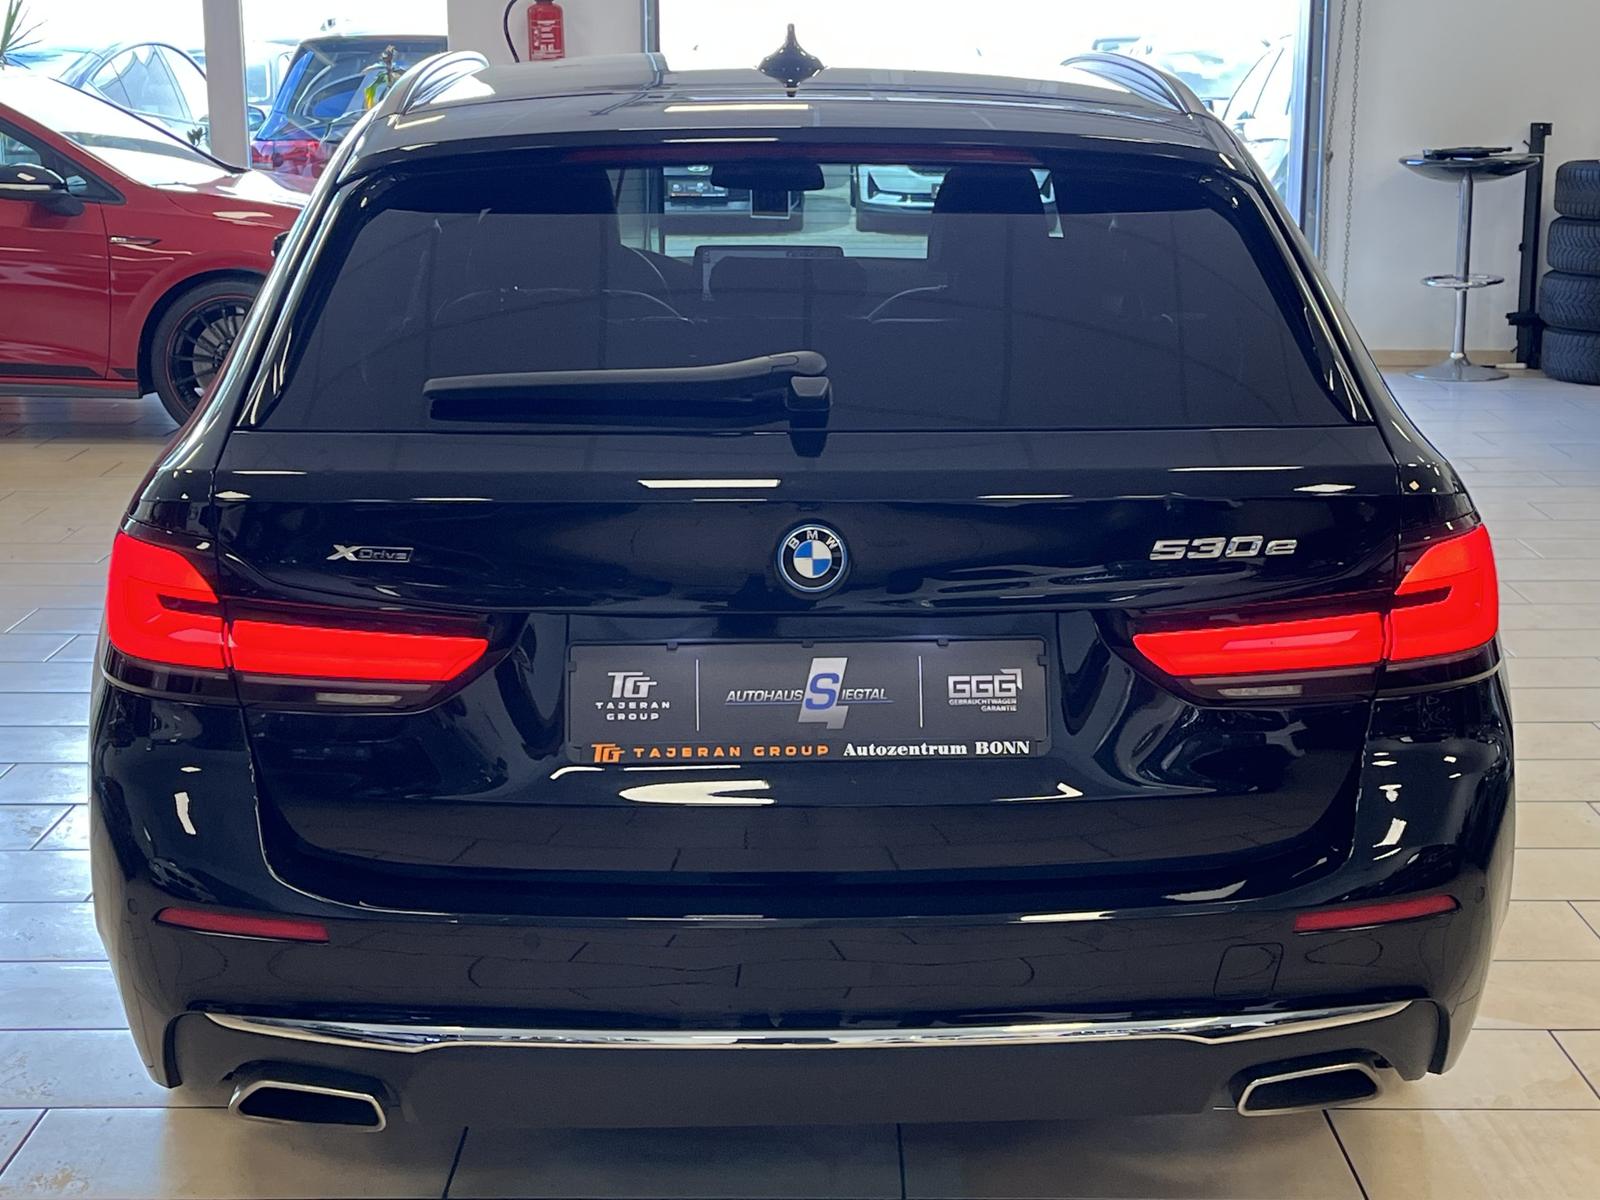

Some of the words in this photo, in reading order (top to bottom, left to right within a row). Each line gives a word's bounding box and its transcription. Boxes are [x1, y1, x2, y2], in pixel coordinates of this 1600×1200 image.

[788, 530, 838, 550] BMW
[608, 671, 657, 698] TG
[948, 675, 1017, 698] GGG
[726, 690, 804, 702] AUTOHAUS
[591, 743, 625, 763] TG
[633, 747, 741, 758] TAJERAN
[753, 745, 829, 756] GROUP
[844, 743, 967, 756] Autozentrum
[975, 741, 1030, 755] BONN
